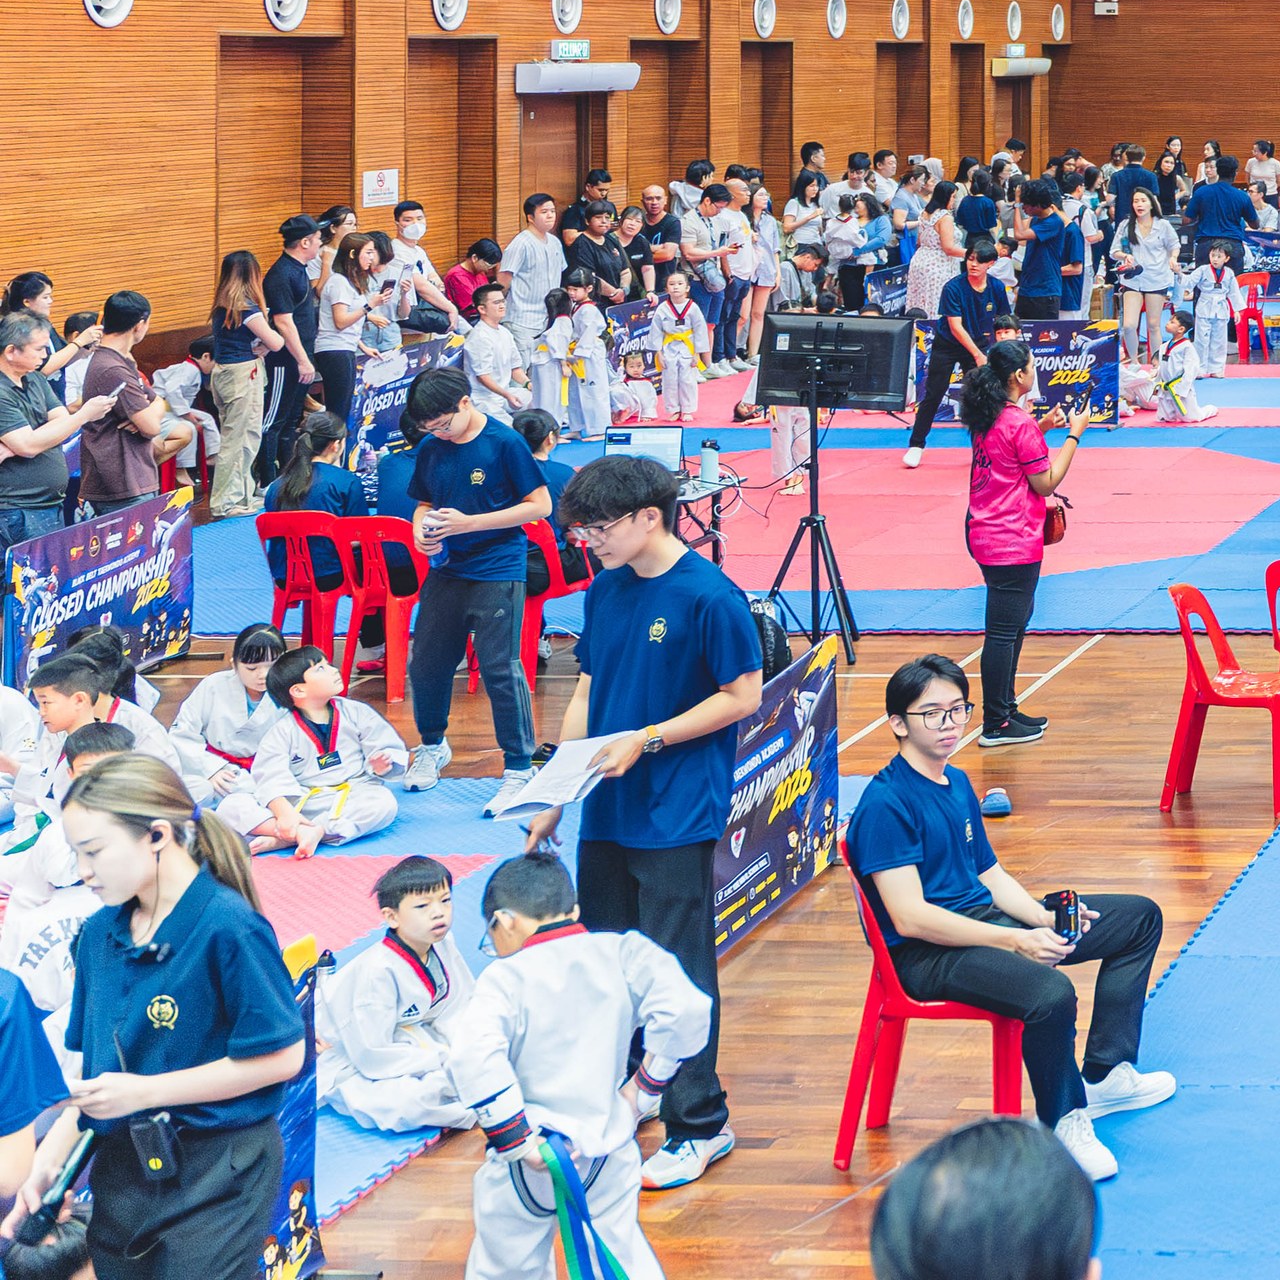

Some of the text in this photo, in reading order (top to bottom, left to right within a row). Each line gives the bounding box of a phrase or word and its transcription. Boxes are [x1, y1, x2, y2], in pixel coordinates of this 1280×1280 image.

[1034, 354, 1096, 371] PIONSHIP
[1048, 368, 1091, 386] 2026
[363, 389, 394, 416] CLOSED
[31, 548, 175, 636] CLOSED CHAMPIONSHIP
[132, 572, 171, 614] 2026
[767, 755, 813, 825] 2026
